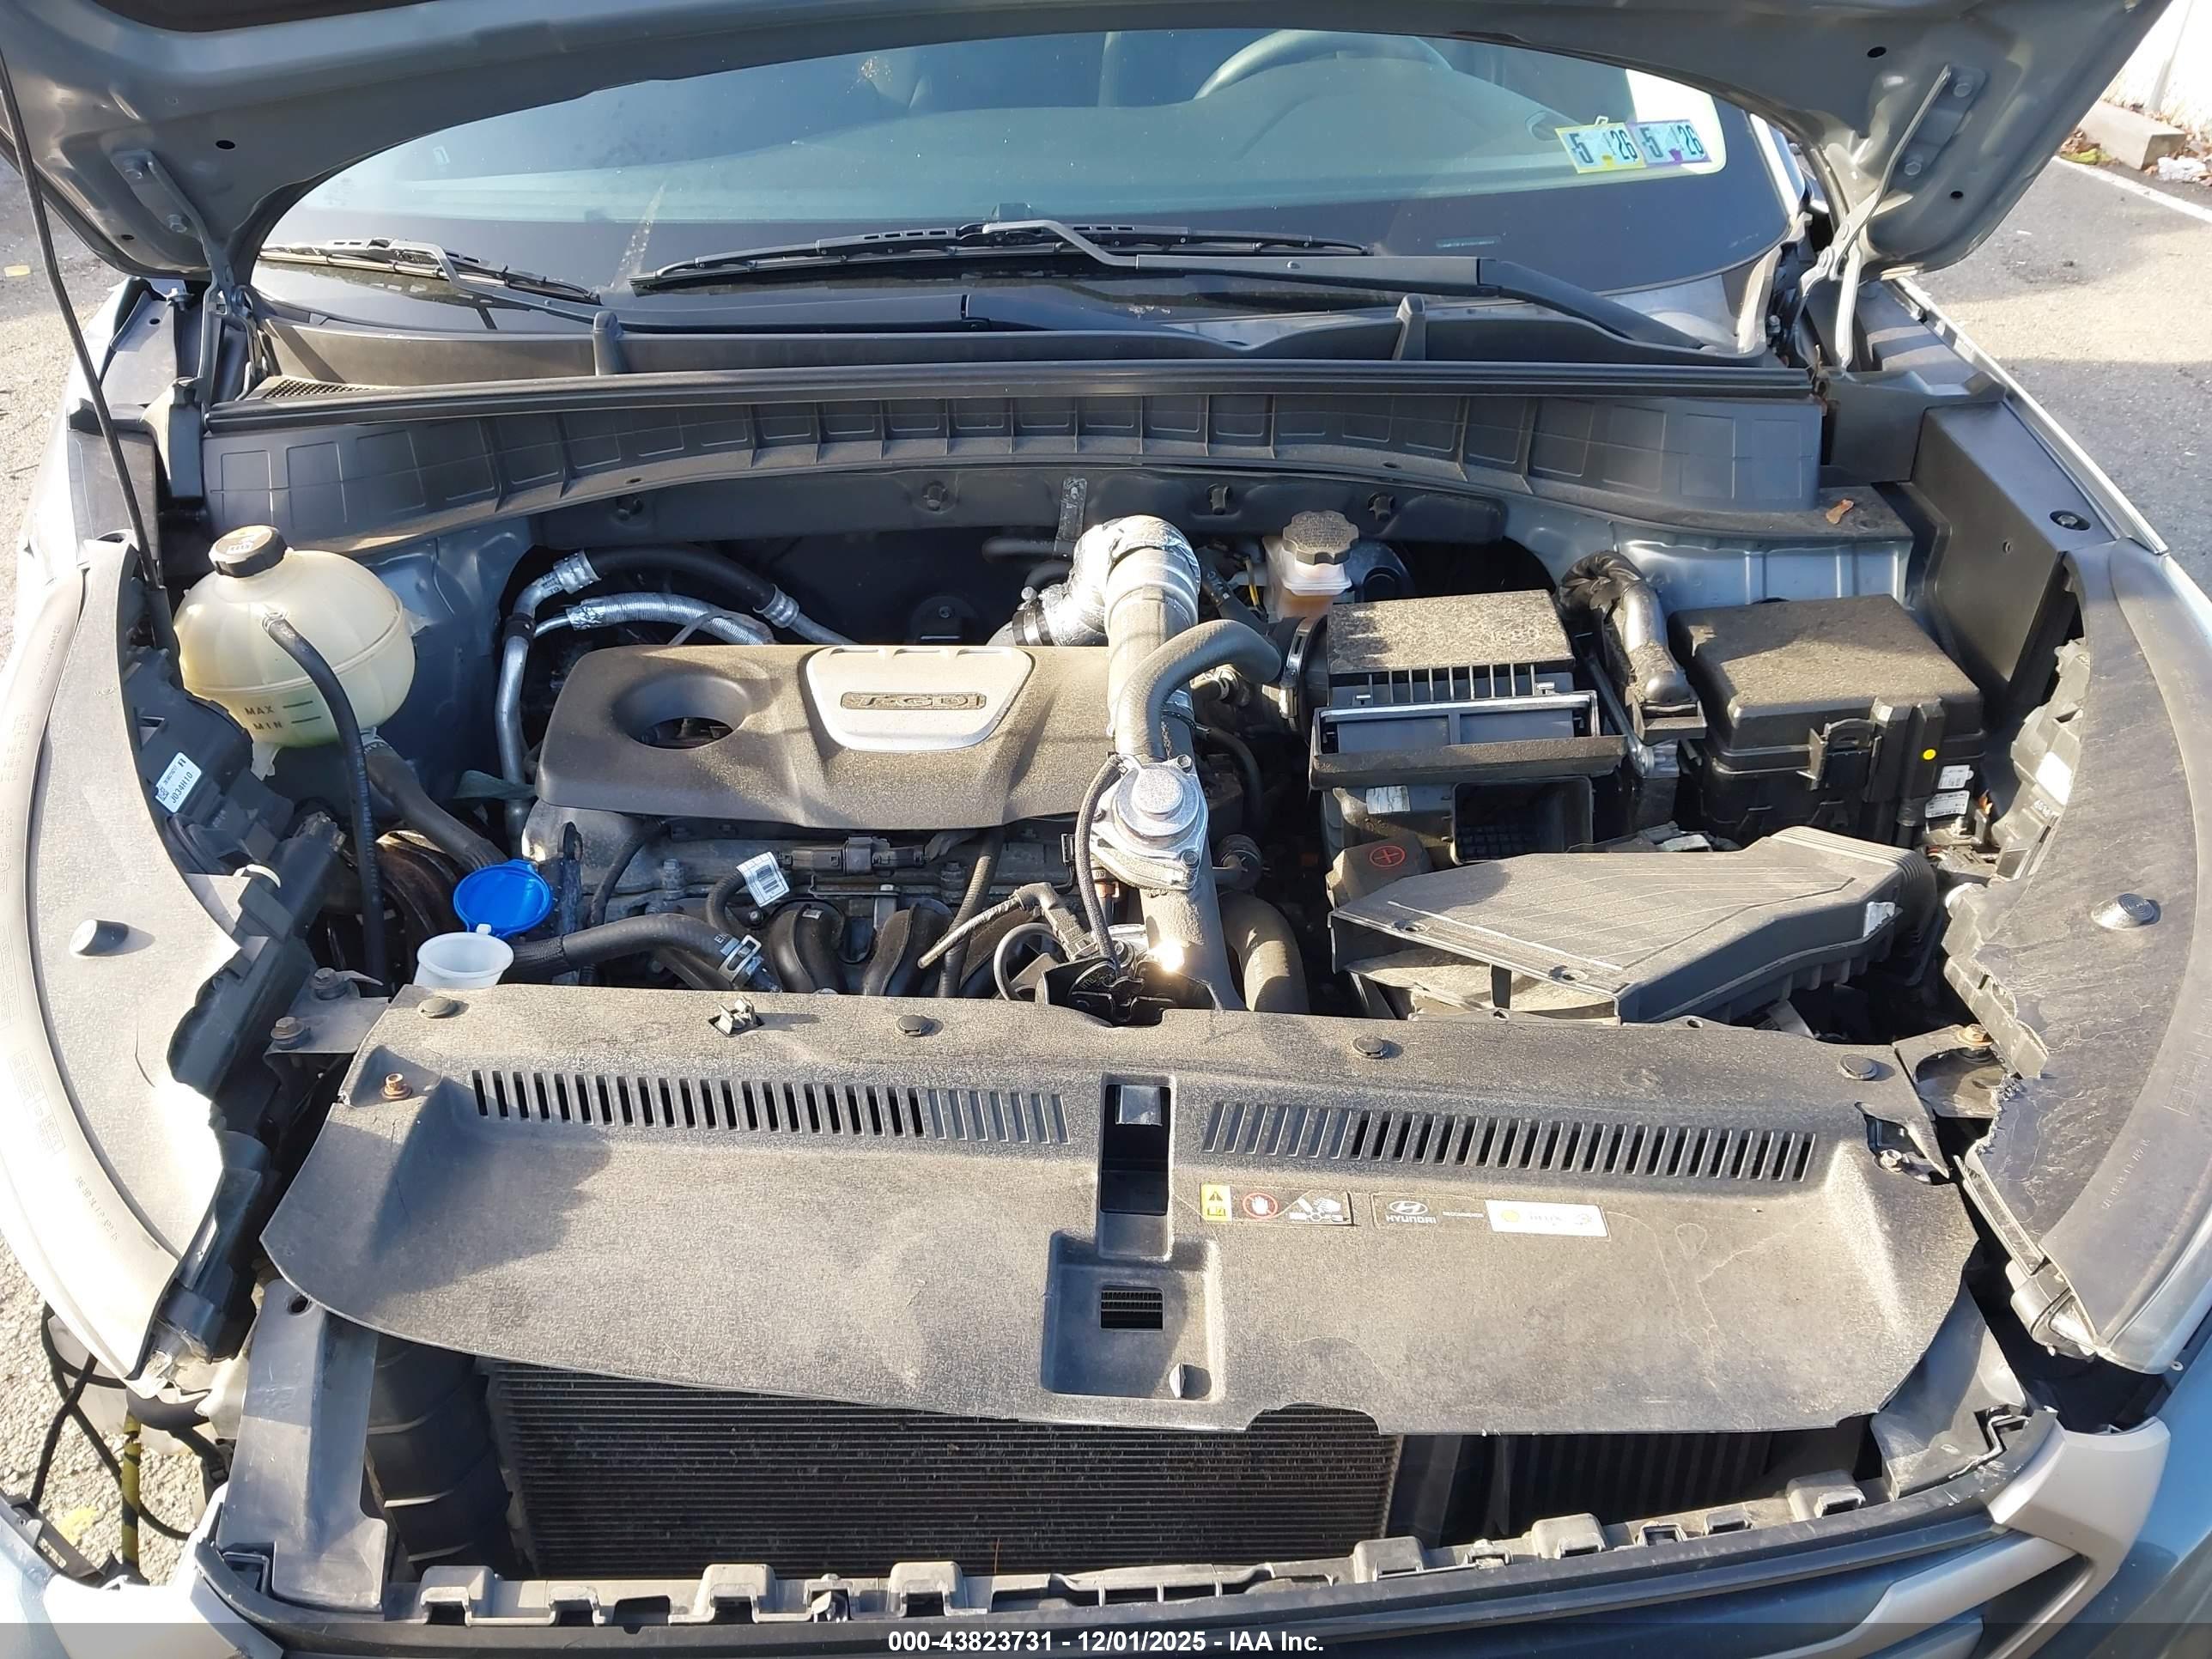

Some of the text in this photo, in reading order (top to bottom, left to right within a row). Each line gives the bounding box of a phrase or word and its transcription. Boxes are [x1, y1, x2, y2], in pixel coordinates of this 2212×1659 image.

[1639, 124, 1705, 158] 5 26
[1569, 130, 1638, 164] 5 26
[244, 705, 276, 715] MAX
[252, 720, 283, 730] MIN
[1385, 1214, 1438, 1224] HYUNDAI
